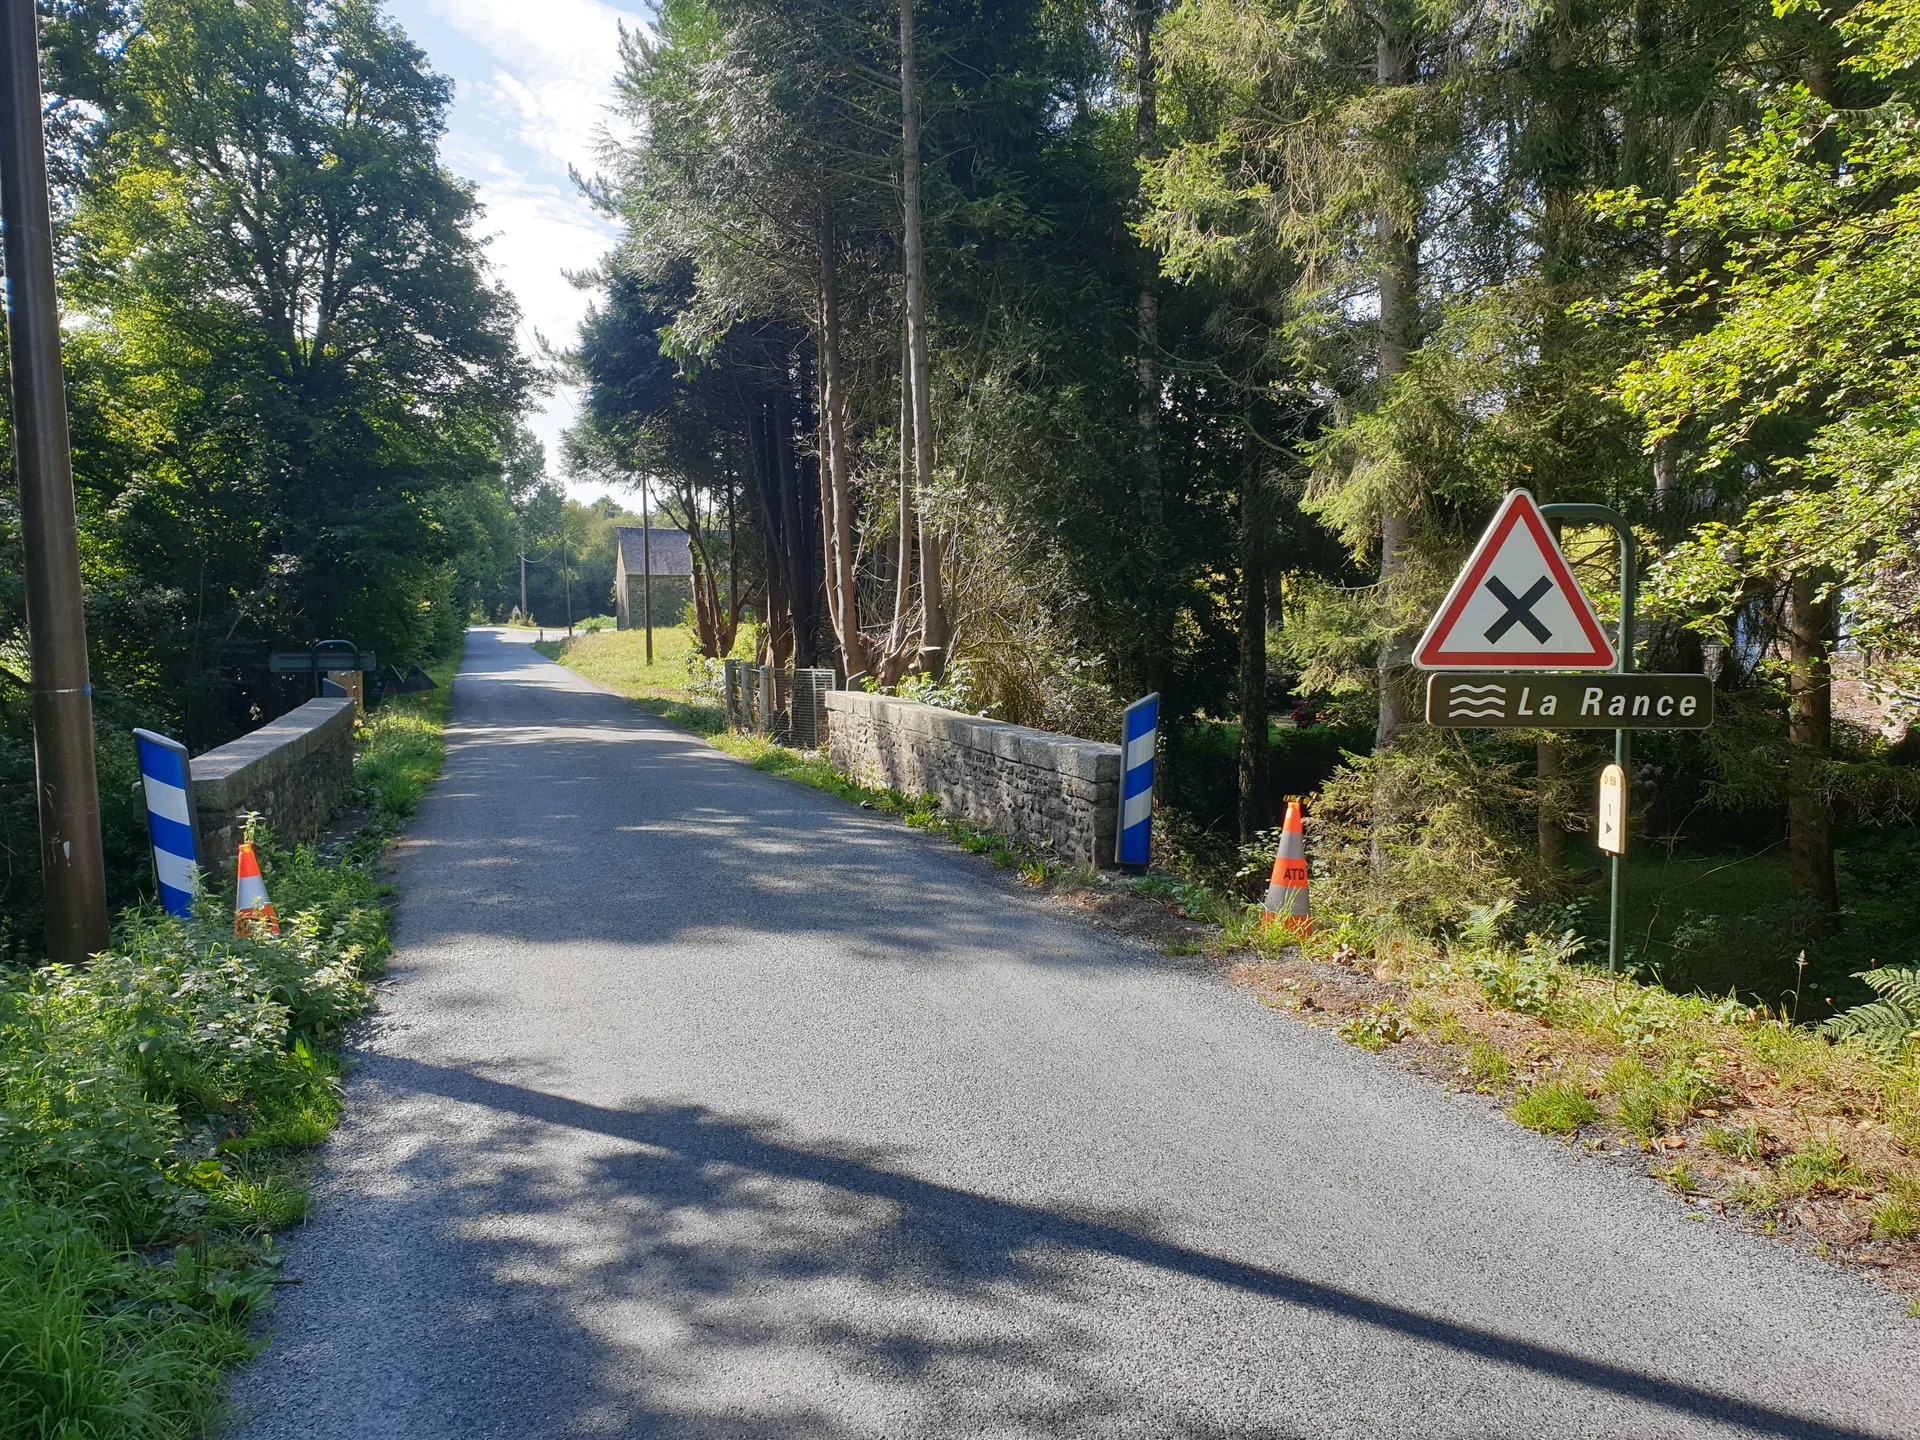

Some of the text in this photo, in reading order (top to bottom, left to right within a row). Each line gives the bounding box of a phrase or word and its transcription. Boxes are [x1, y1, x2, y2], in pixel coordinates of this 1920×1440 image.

[1517, 687, 1697, 716] La Rance
[1604, 775, 1609, 784] D
[1283, 868, 1305, 880] ATD
